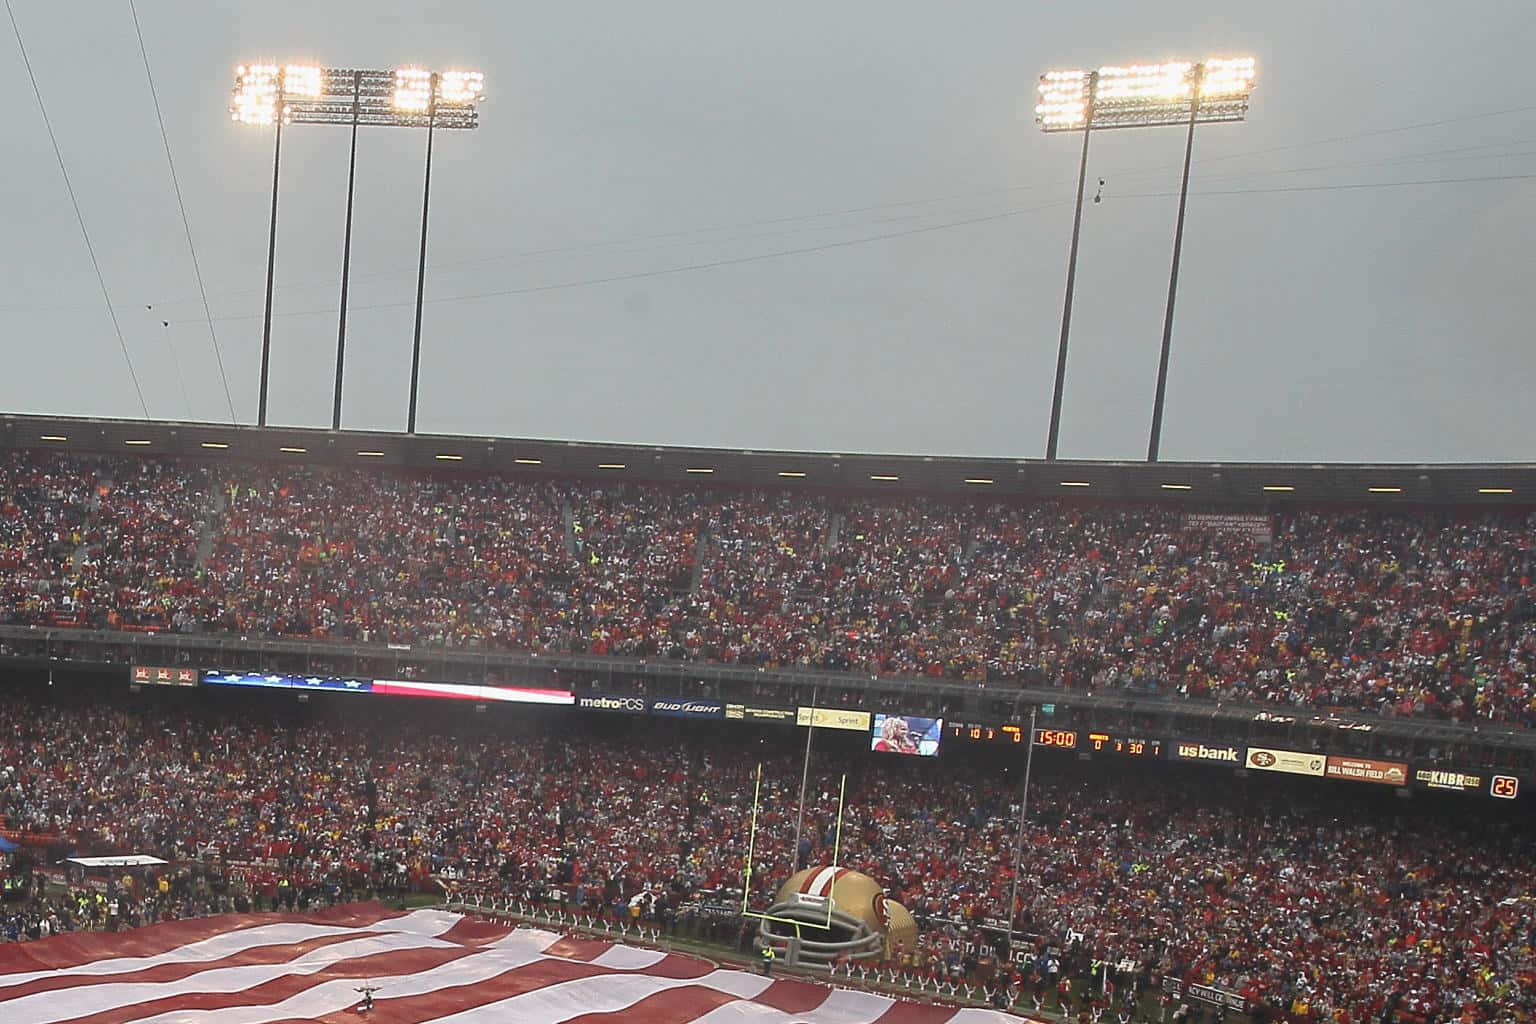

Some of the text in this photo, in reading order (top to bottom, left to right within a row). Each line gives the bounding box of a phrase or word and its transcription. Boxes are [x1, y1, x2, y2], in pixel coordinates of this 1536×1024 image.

[580, 697, 644, 711] metroPCS
[654, 702, 680, 711] BUD
[685, 704, 720, 713] LIGHT
[1040, 731, 1074, 746] 15:00
[1129, 743, 1143, 754] 30
[1328, 766, 1384, 779] BILL WALSH FIELD
[1431, 771, 1464, 785] KNBR
[1495, 779, 1514, 796] 25
